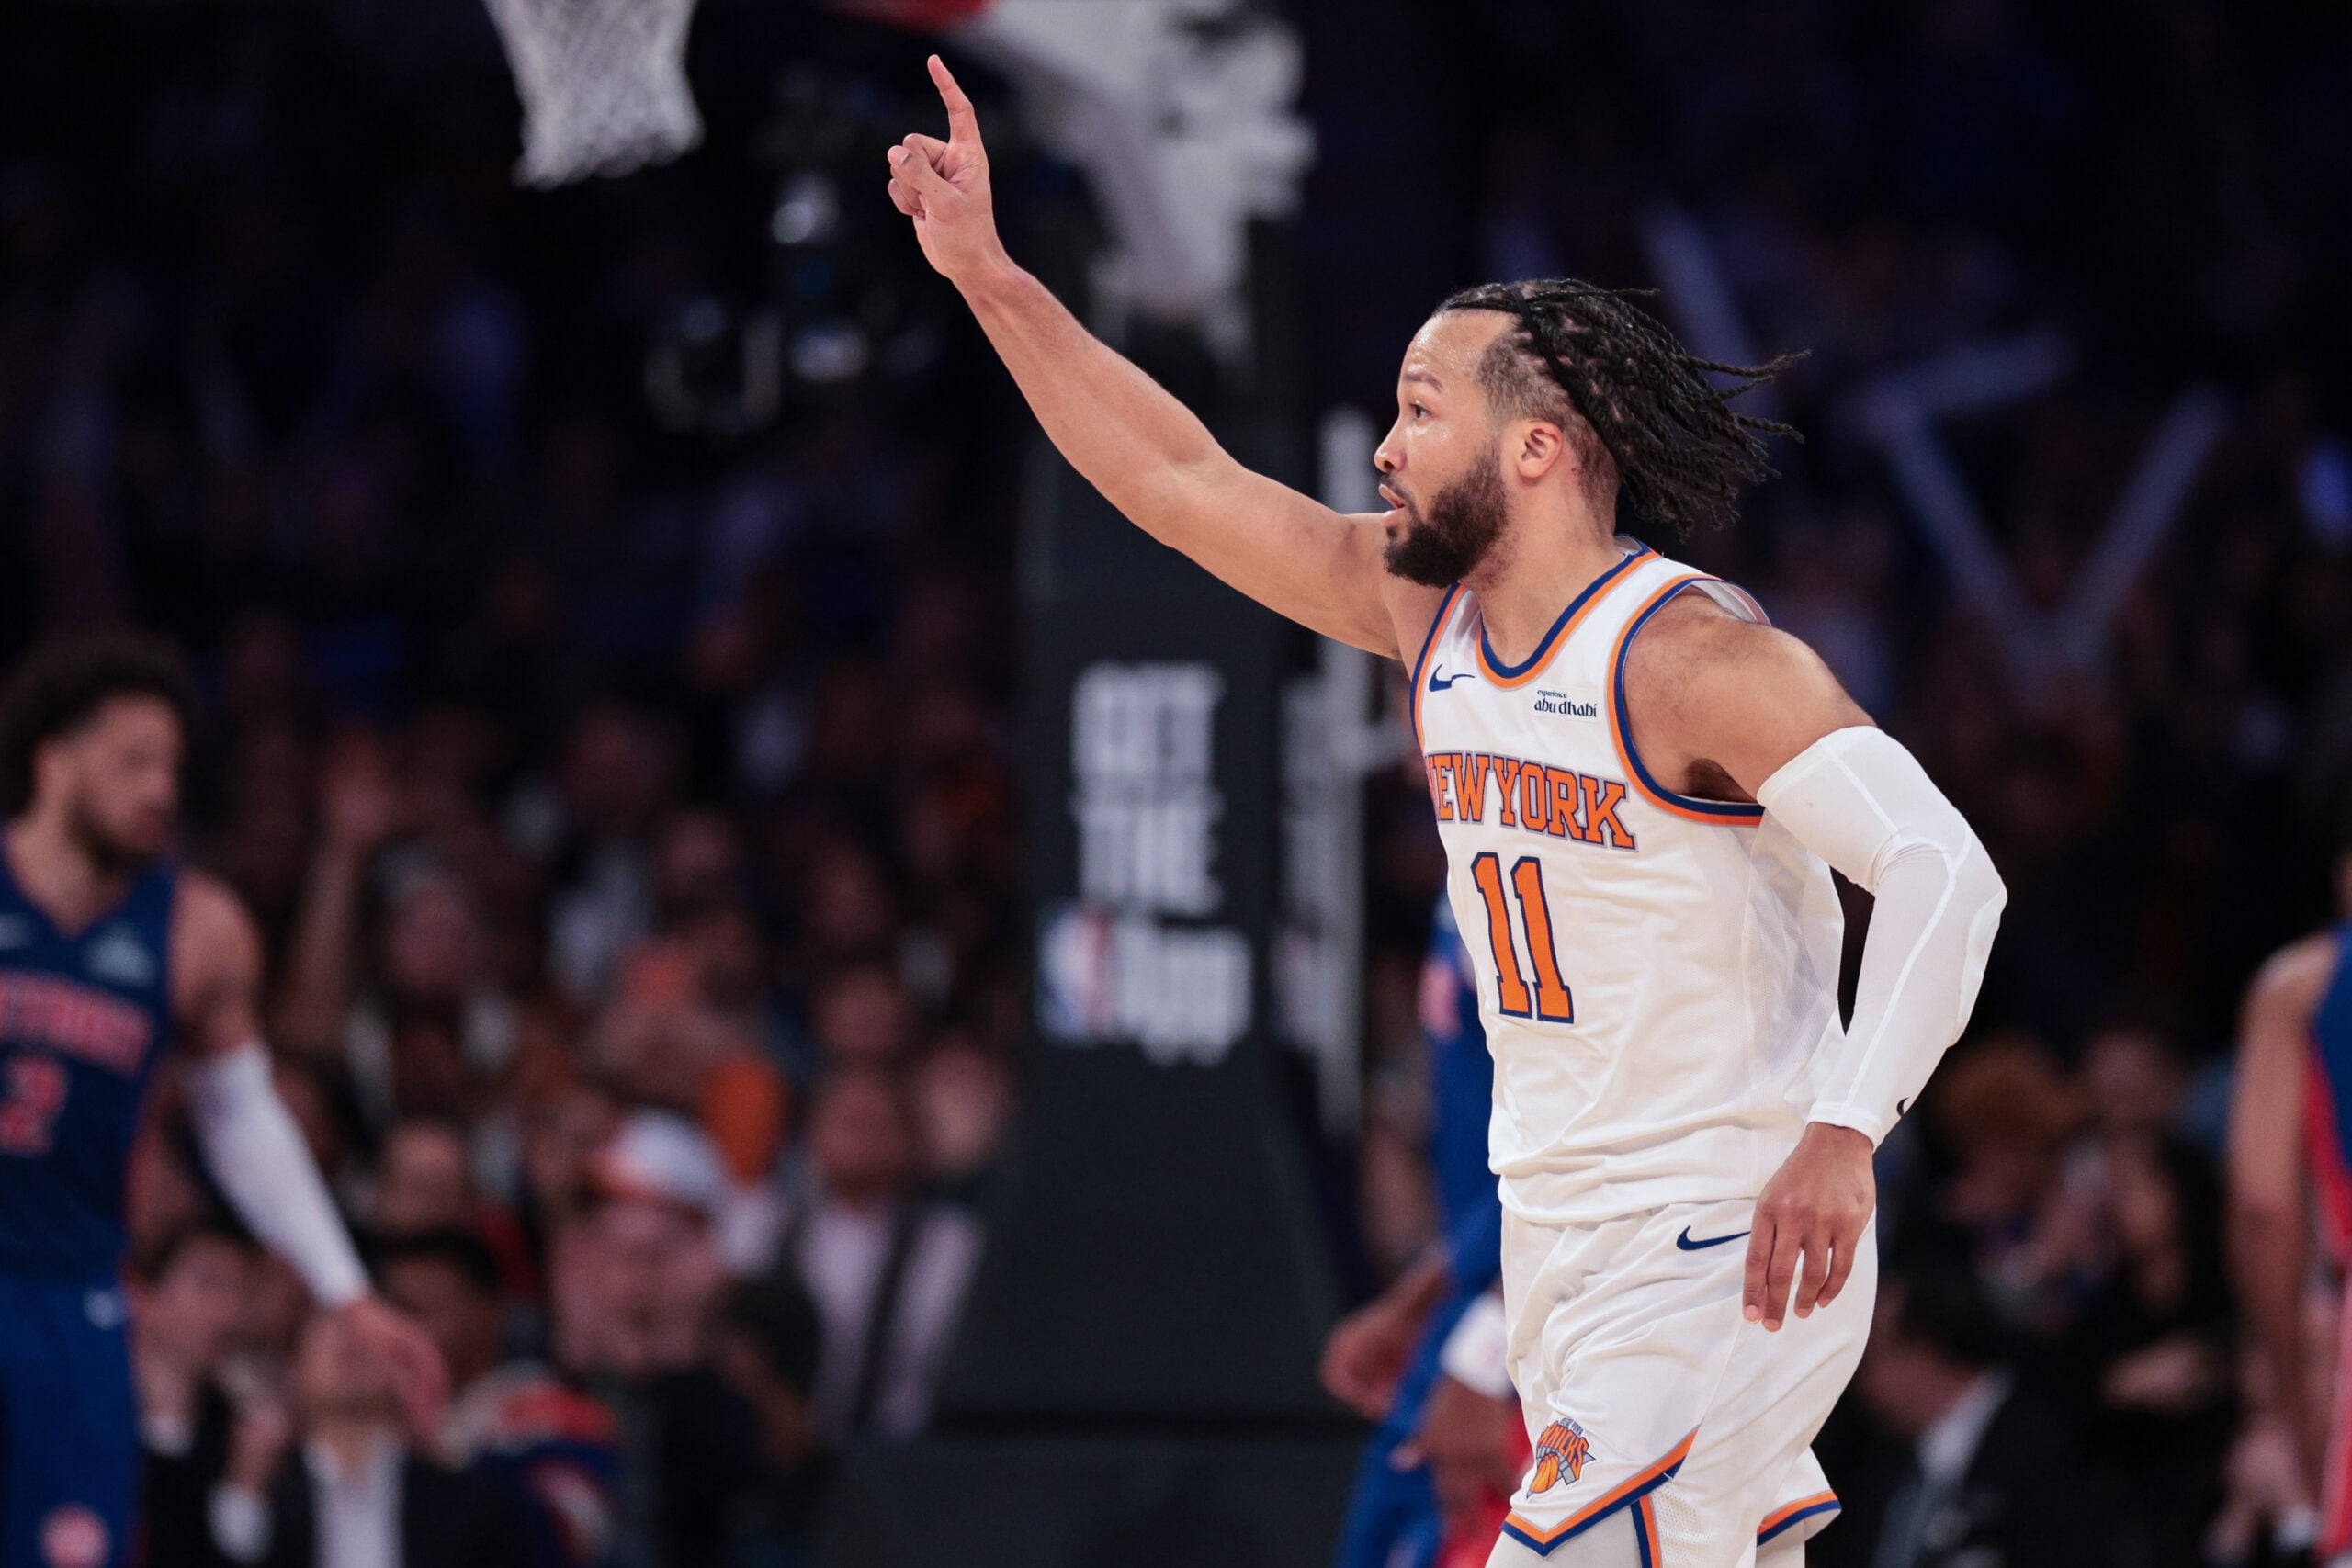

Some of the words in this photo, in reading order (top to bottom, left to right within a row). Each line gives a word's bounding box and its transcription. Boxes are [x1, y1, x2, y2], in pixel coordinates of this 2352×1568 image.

[1534, 698, 1556, 713] abu
[1558, 700, 1597, 717] dhabi
[1537, 690, 1567, 698] experience
[1492, 755, 1637, 851] YORK
[1470, 852, 1574, 1023] 11
[1537, 1421, 1589, 1480] KNICKS
